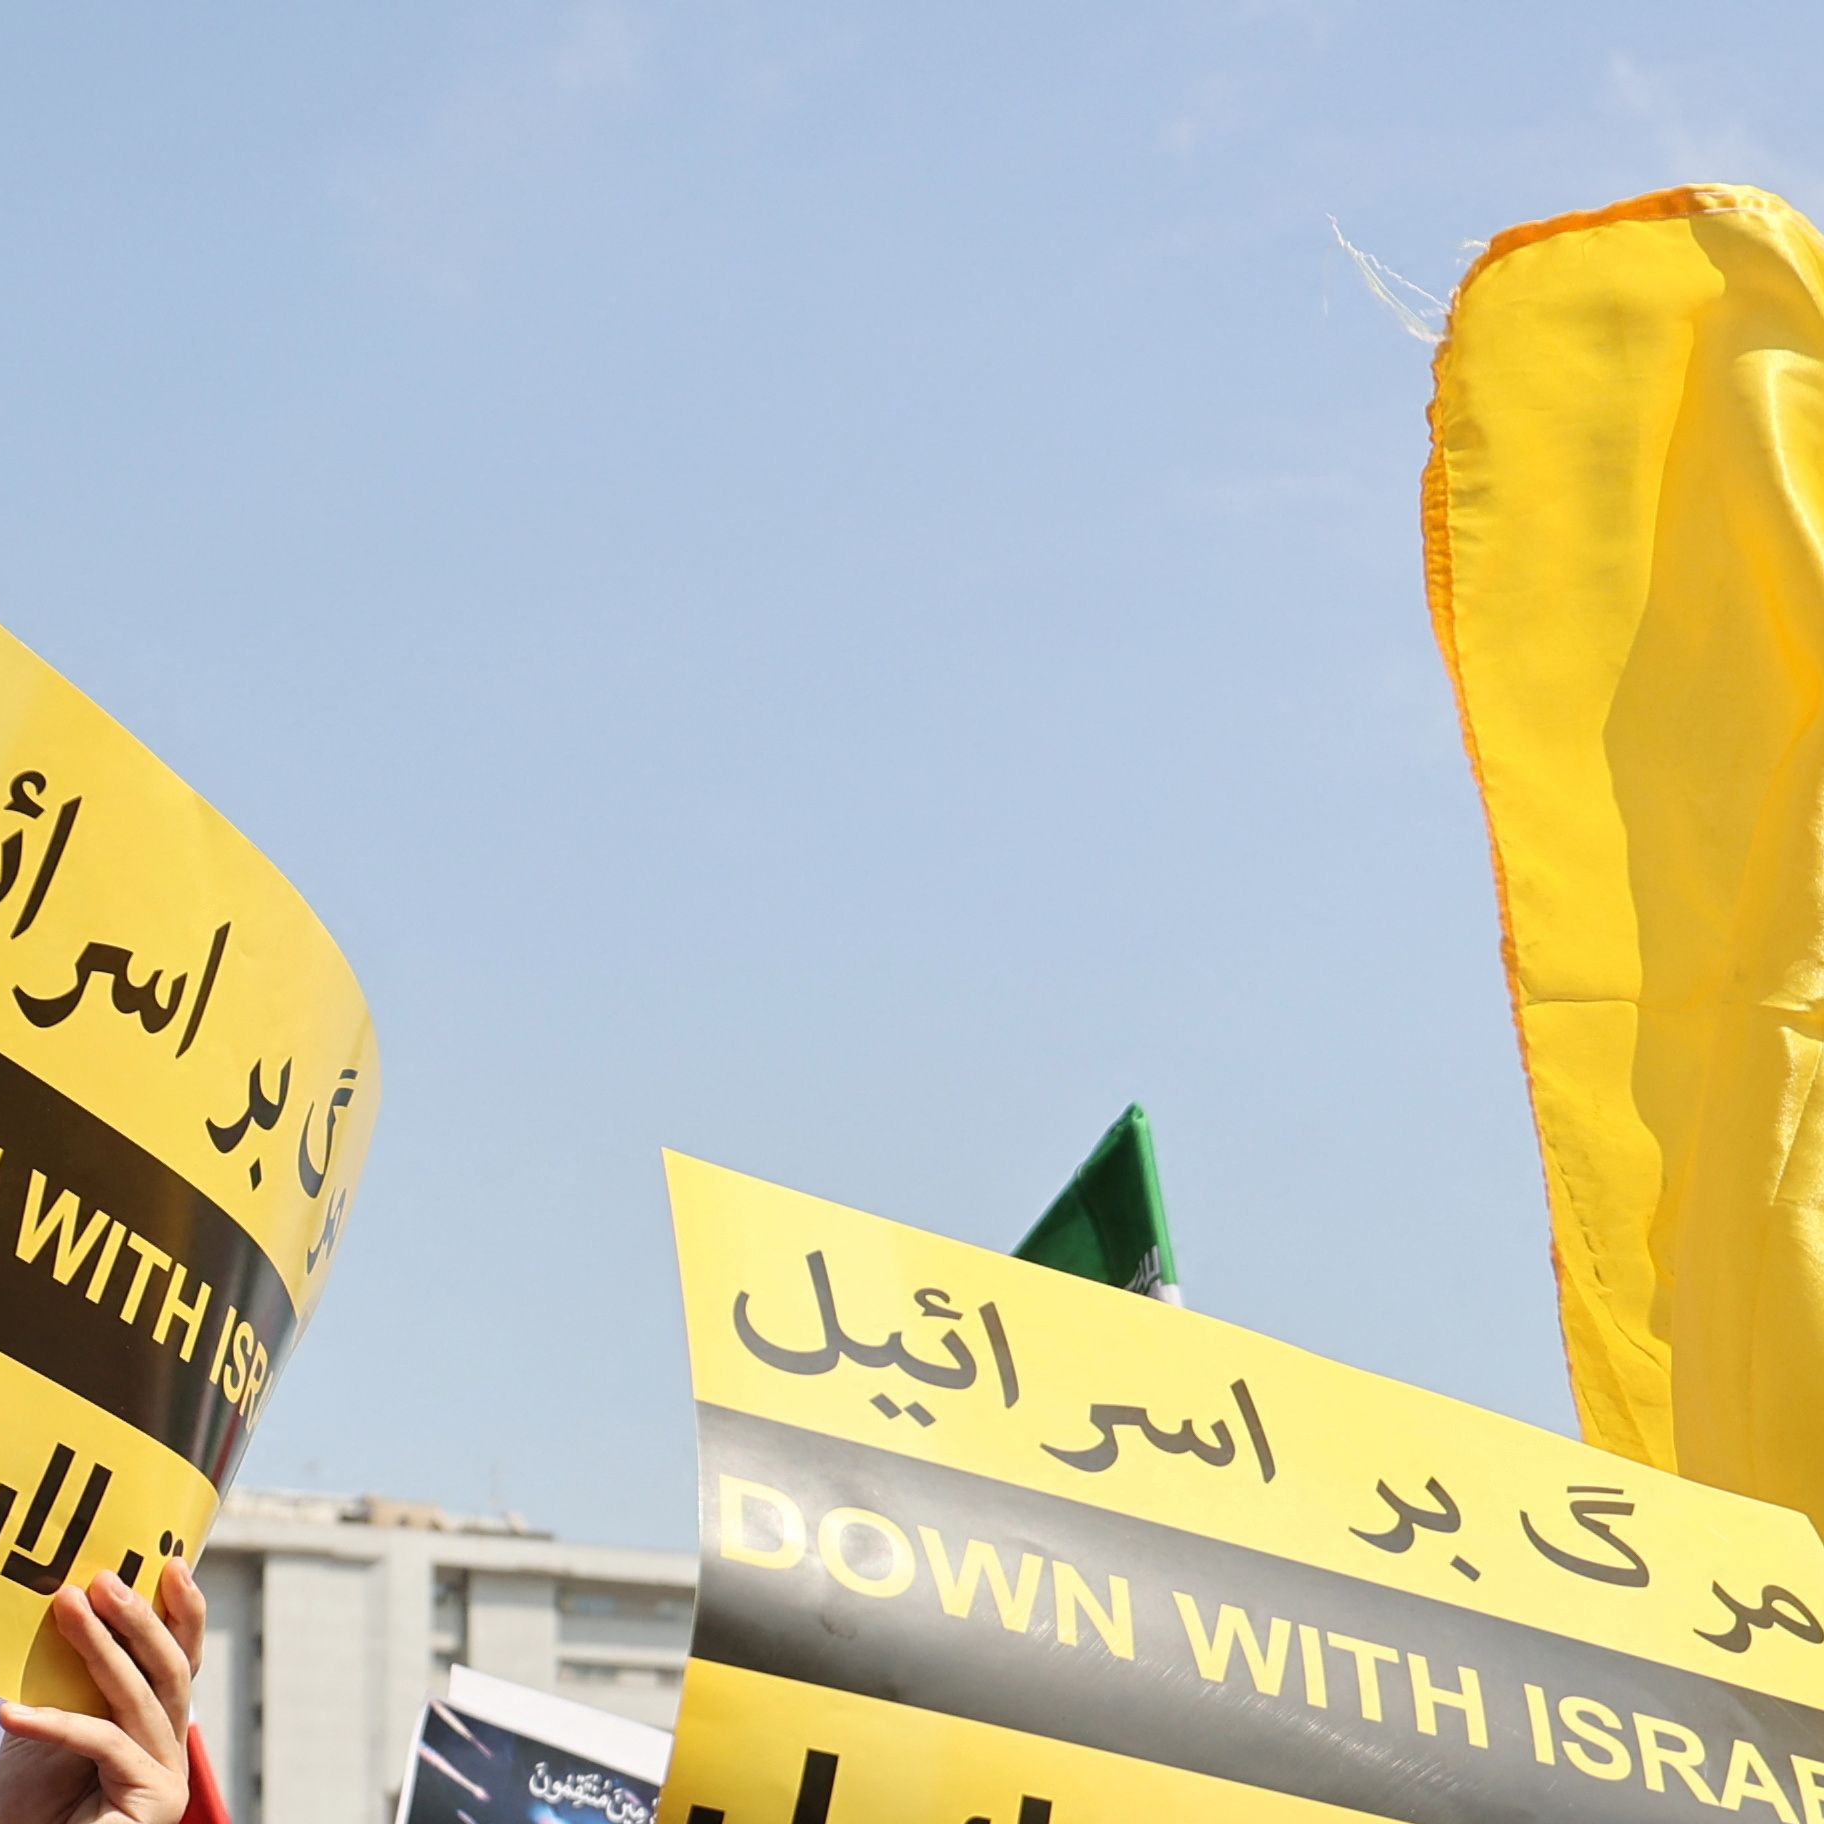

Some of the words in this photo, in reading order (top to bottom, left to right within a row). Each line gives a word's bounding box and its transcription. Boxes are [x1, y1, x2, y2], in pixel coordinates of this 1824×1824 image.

[205, 1055, 293, 1193] بر
[14, 1169, 212, 1362] WITH
[732, 1250, 1277, 1484] اسرائیل
[719, 1474, 1135, 1661] DOWN
[1172, 1588, 1487, 1748] WITH
[1350, 1476, 1483, 1582] بر
